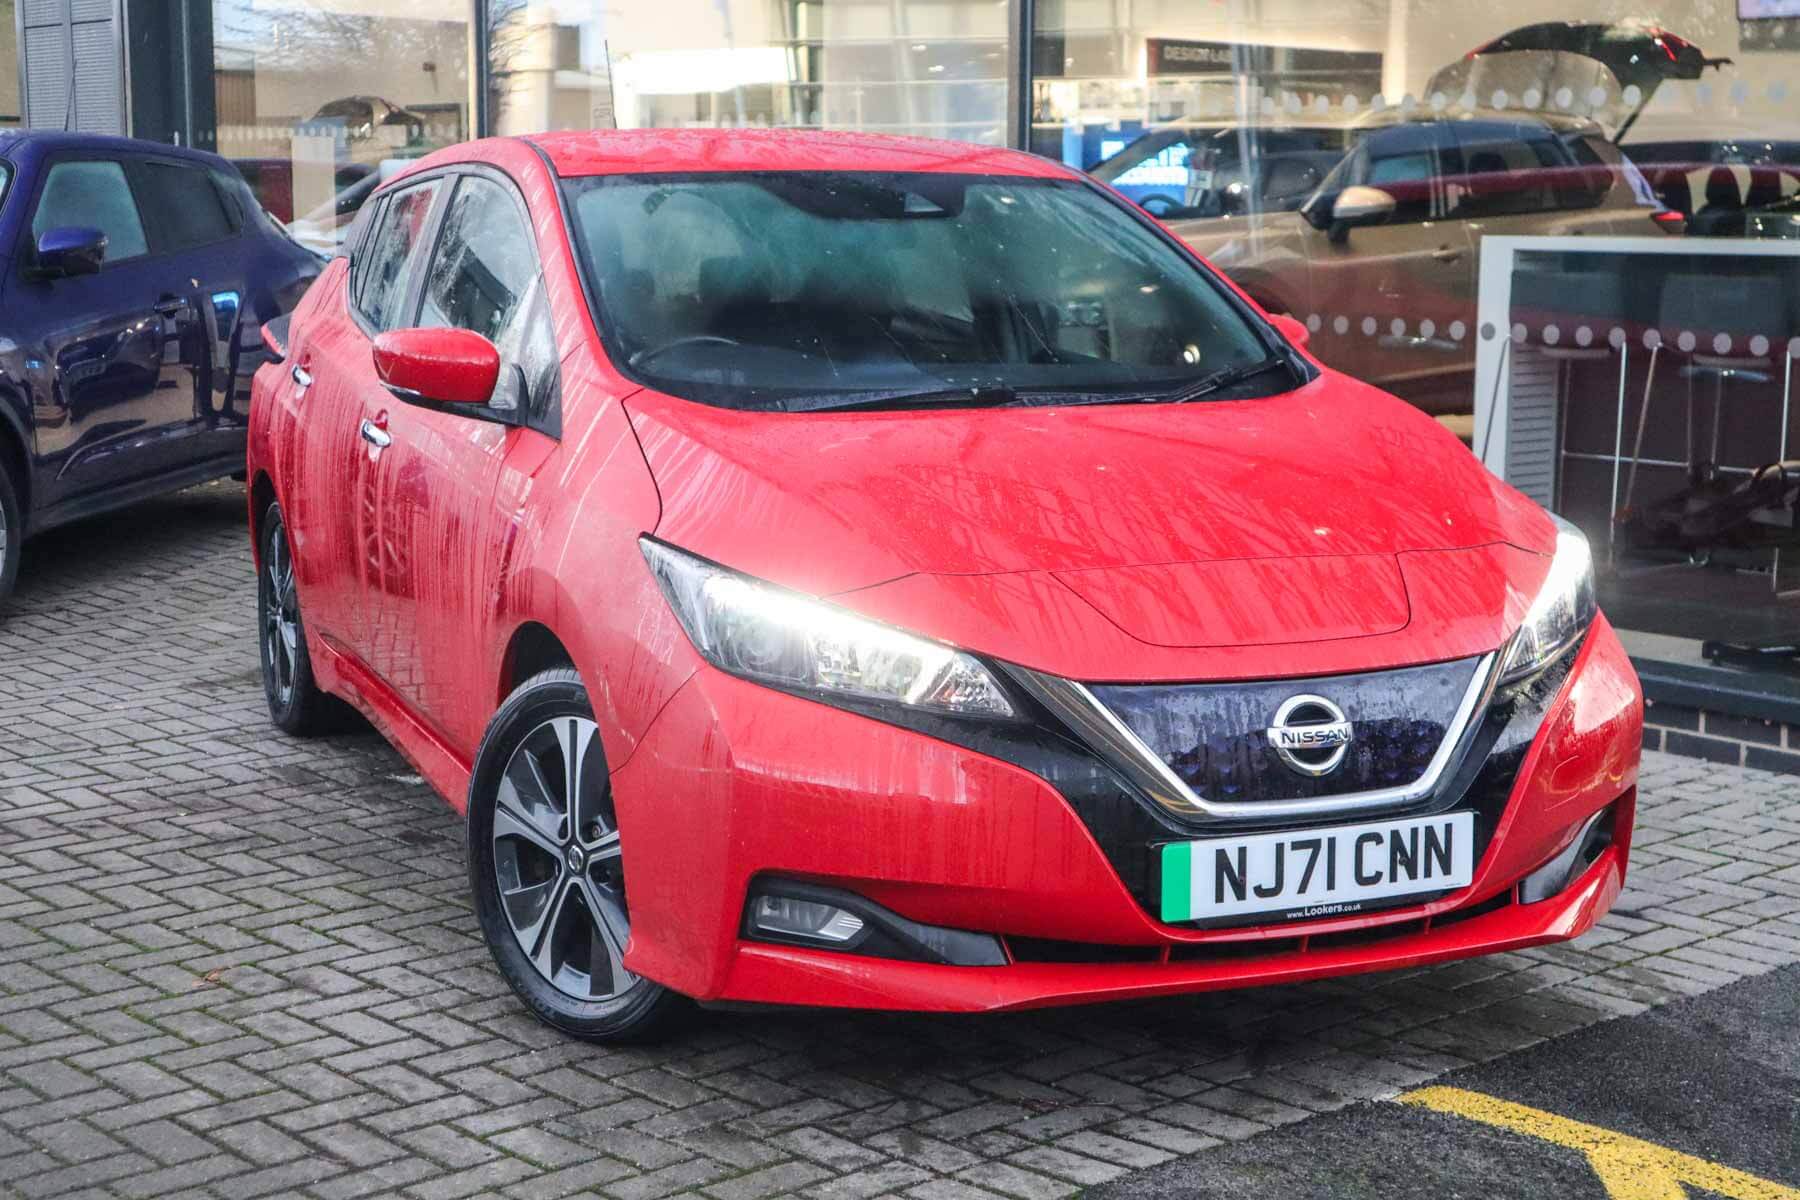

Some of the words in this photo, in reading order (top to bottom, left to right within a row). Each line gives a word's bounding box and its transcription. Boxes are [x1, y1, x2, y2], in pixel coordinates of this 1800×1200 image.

[1281, 728, 1349, 744] NISSAN
[1215, 837, 1336, 903] NJ71
[1354, 823, 1453, 887] CNN
[1286, 903, 1361, 919] www.Lookers.co.uk
